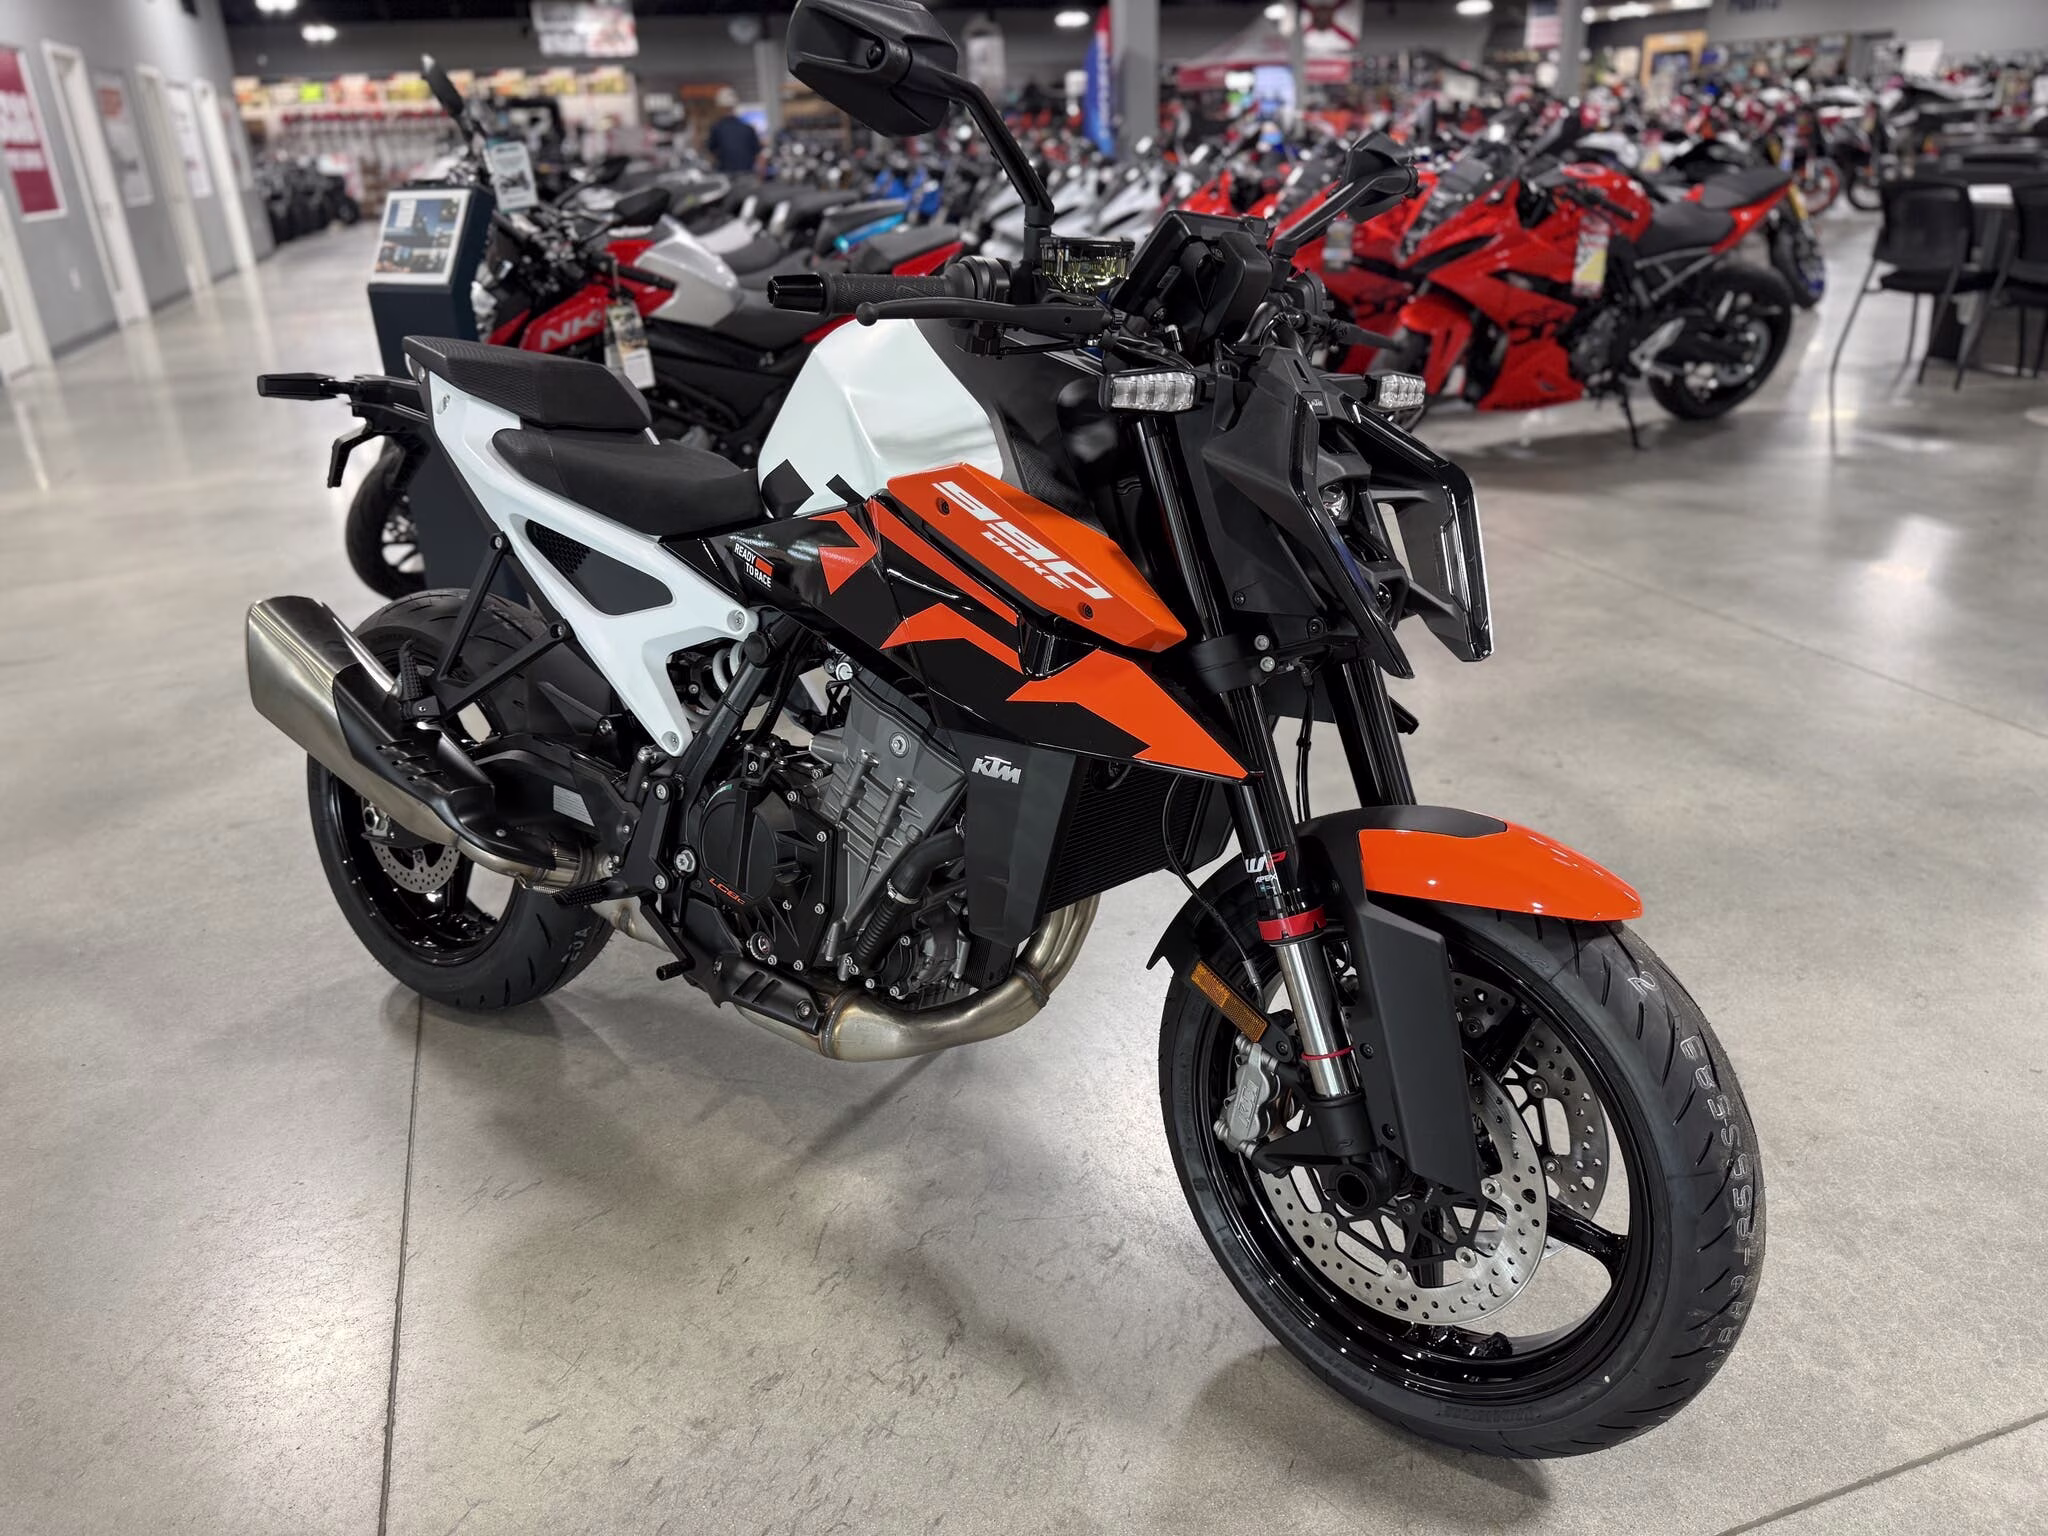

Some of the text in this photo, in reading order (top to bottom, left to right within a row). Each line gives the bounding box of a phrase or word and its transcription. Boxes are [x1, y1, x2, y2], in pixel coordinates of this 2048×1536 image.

[734, 542, 757, 565] READY
[932, 480, 1113, 600] 990
[745, 561, 772, 589] TO RACE
[980, 530, 1071, 590] DUKE
[971, 755, 1022, 785] KTM
